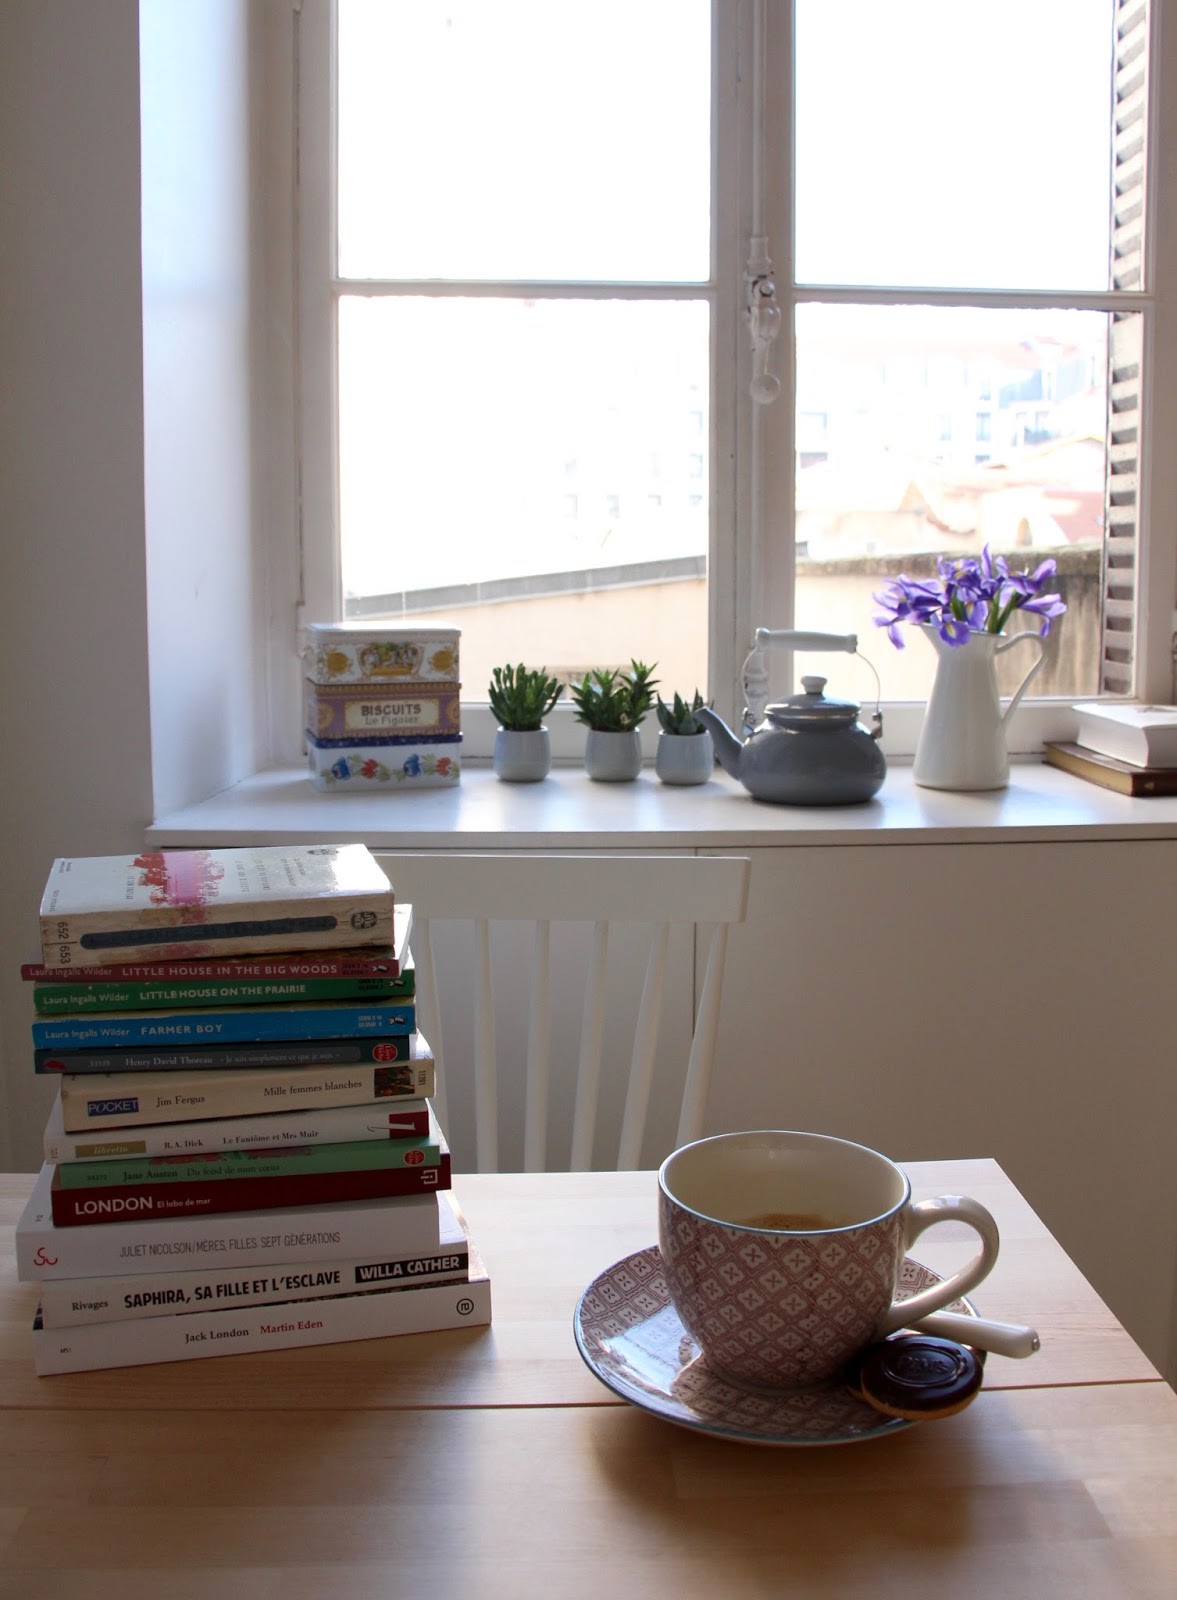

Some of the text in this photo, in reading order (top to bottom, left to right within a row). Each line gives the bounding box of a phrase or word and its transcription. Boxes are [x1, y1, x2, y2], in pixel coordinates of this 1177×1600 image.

[361, 703, 421, 717] BISCUITS
[365, 715, 419, 727] Le Figuier
[57, 921, 69, 939] 652
[59, 945, 71, 964] 653
[29, 967, 54, 976] Laura
[55, 967, 81, 978] Ingalls
[84, 966, 113, 976] Wilder
[122, 967, 165, 976] LITTLE
[169, 966, 213, 976] HOUSE
[217, 966, 231, 975] IN
[235, 966, 261, 975] THE
[265, 965, 287, 975] BIG
[290, 964, 338, 974] WOODS
[43, 985, 306, 1005] Laura Ingalls Wilder LITTLE HOUSE ON THE PRAIRIE
[45, 1024, 223, 1039] Laura Ingalls Wilder FARMER BOY
[125, 1057, 152, 1068] Henry
[153, 1056, 177, 1066] David
[178, 1055, 213, 1065] Thoreau
[88, 1080, 363, 1115] POCKET Jim Fergus Mille femmes blanches
[184, 1139, 204, 1148] Dick
[223, 1136, 233, 1145] Le
[235, 1133, 271, 1144] Fantôme
[281, 1131, 298, 1140] Mrs
[299, 1129, 319, 1139] Muir
[122, 1170, 144, 1182] Jane
[146, 1169, 178, 1180] Austen
[186, 1167, 201, 1177] Du
[224, 1165, 235, 1175] de
[74, 1196, 211, 1215] LONDON El lobo de mar
[119, 1244, 146, 1258] JULIET
[261, 1235, 282, 1248] SEPT
[284, 1231, 341, 1247] GÉNÉRATIONS
[71, 1300, 109, 1312] Rivages
[124, 1289, 191, 1309] SAPHIRA,
[194, 1285, 213, 1301] SA
[216, 1281, 250, 1298] FILLE
[252, 1279, 269, 1293] ET
[360, 1263, 404, 1280] WILLA
[406, 1256, 460, 1274] CATHER
[184, 1320, 324, 1345] Jack London Martin Eden
